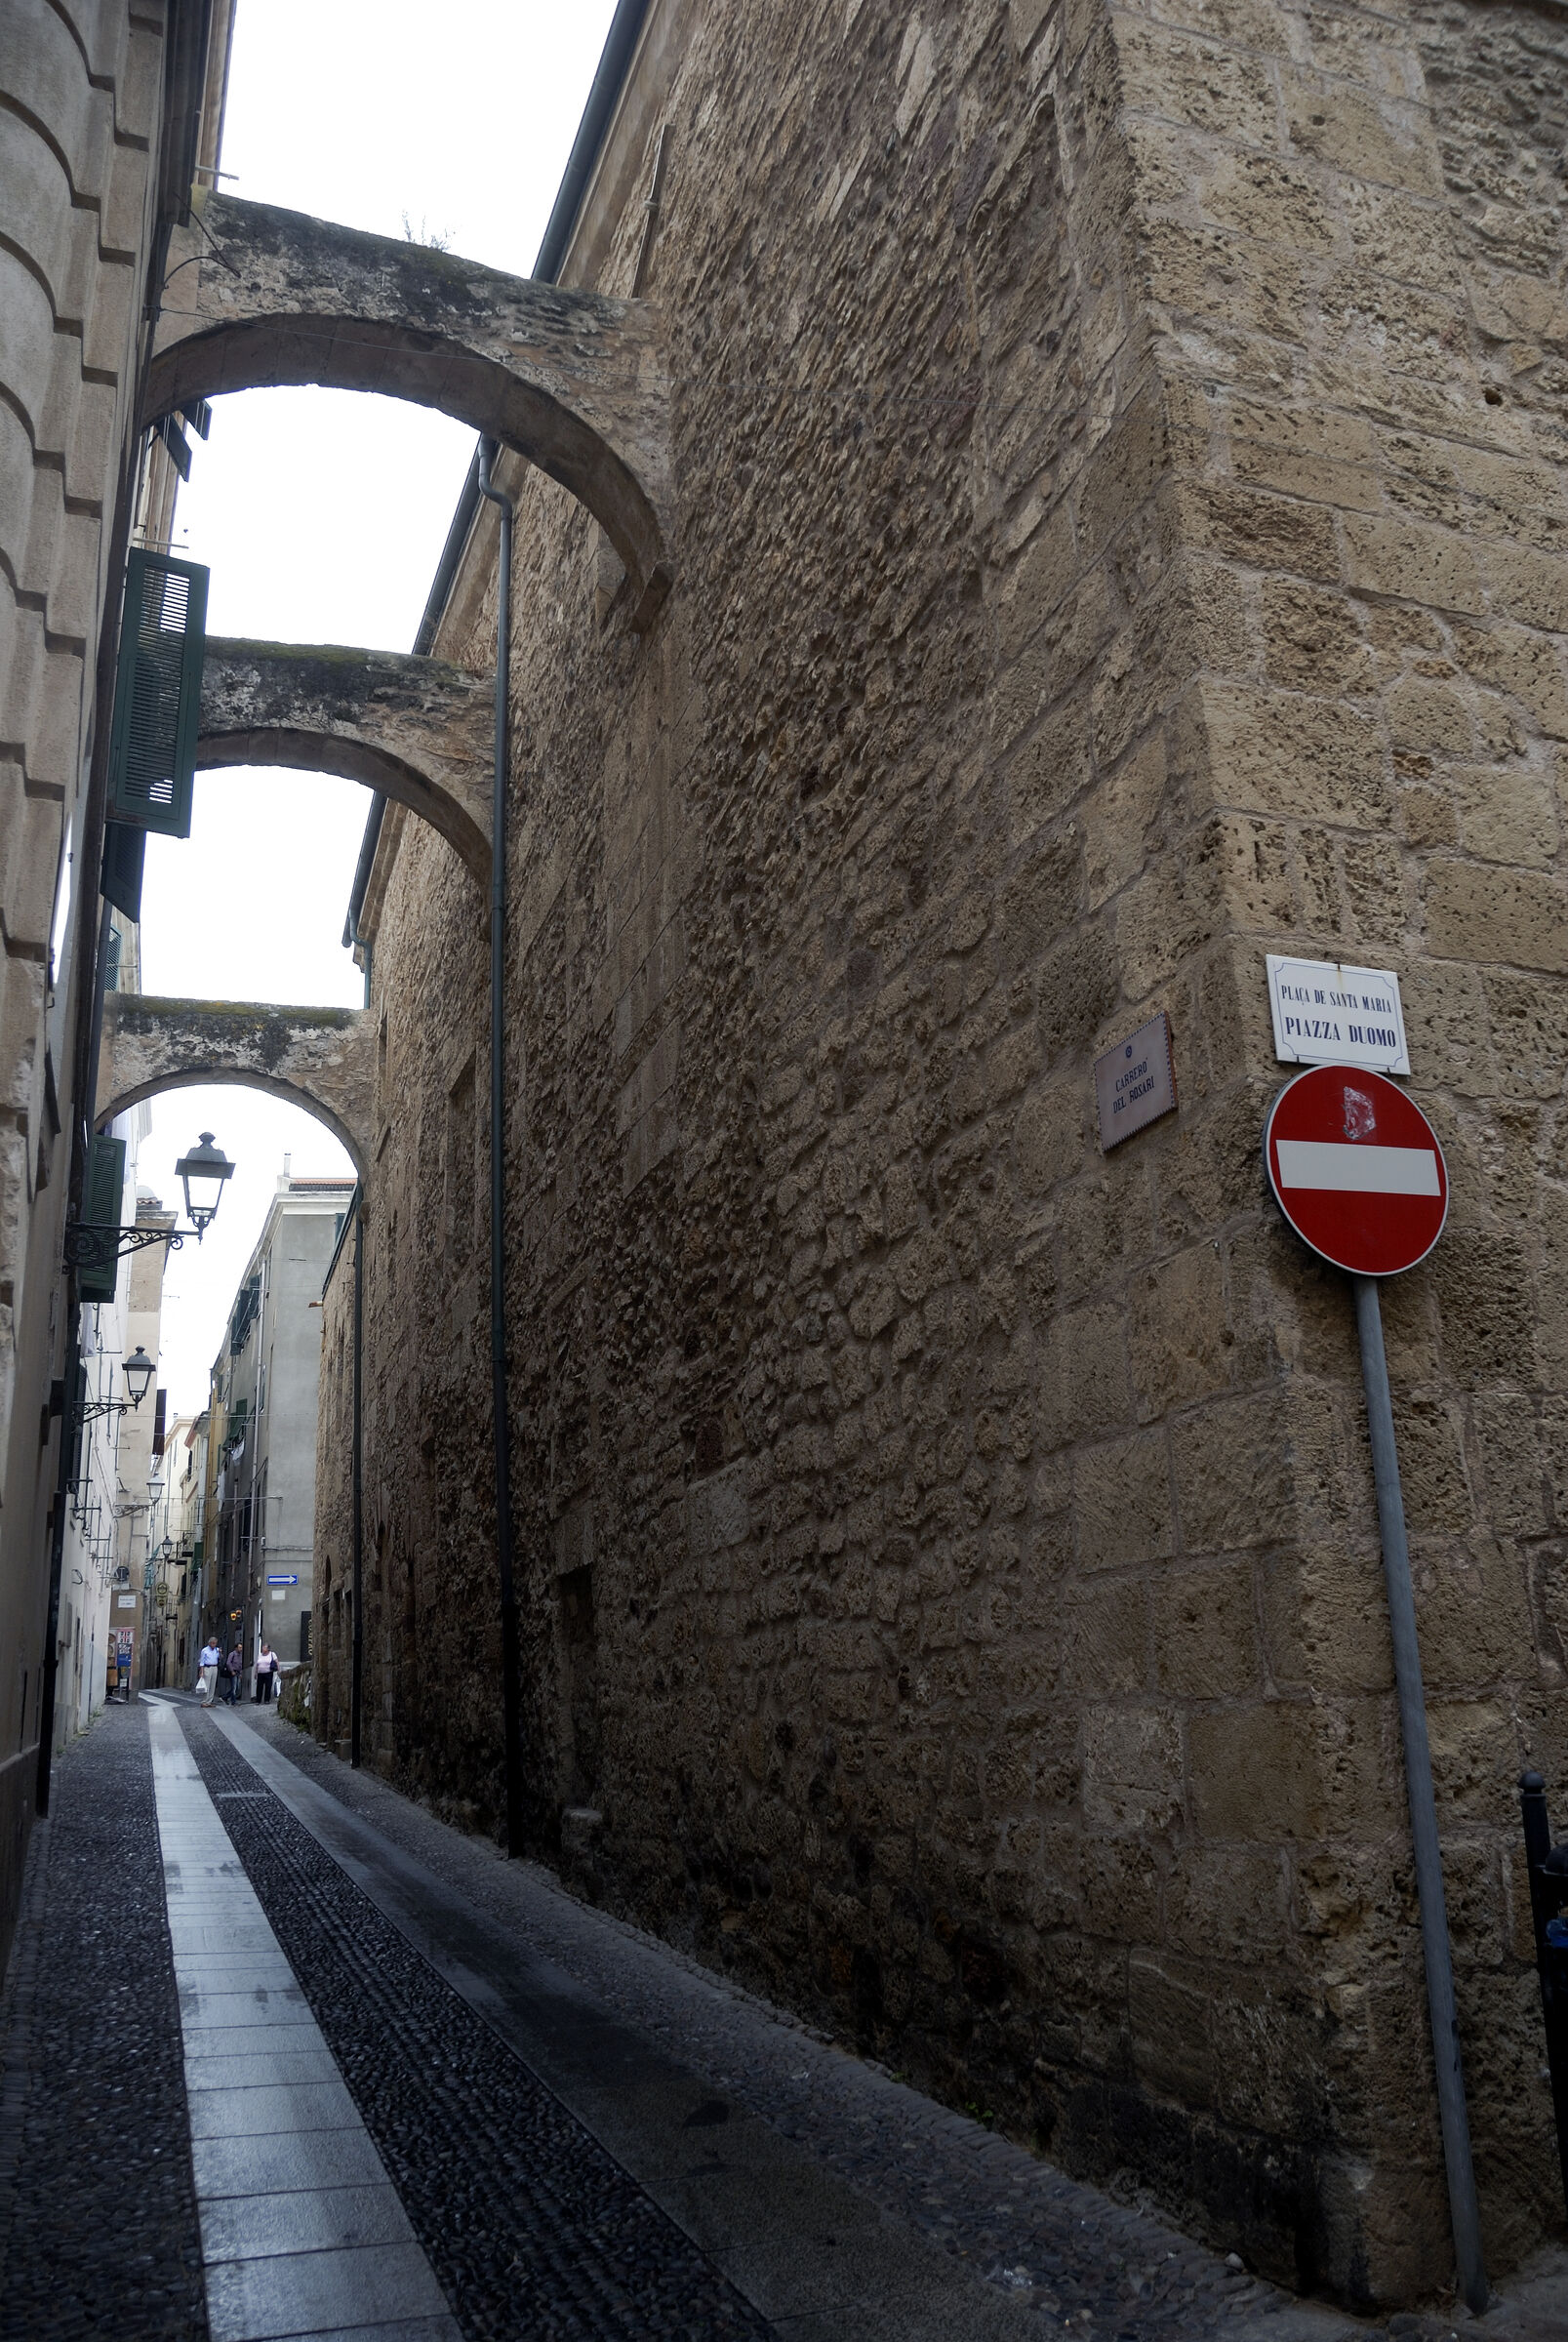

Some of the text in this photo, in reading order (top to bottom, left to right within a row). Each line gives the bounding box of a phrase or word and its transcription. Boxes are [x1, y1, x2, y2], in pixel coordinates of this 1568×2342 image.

[1281, 985, 1392, 1013] PLAÇA DE SANTA MARIA
[1285, 1016, 1396, 1047] PIAZZA DUOMO
[1112, 1075, 1154, 1113] DEL ROSARI
